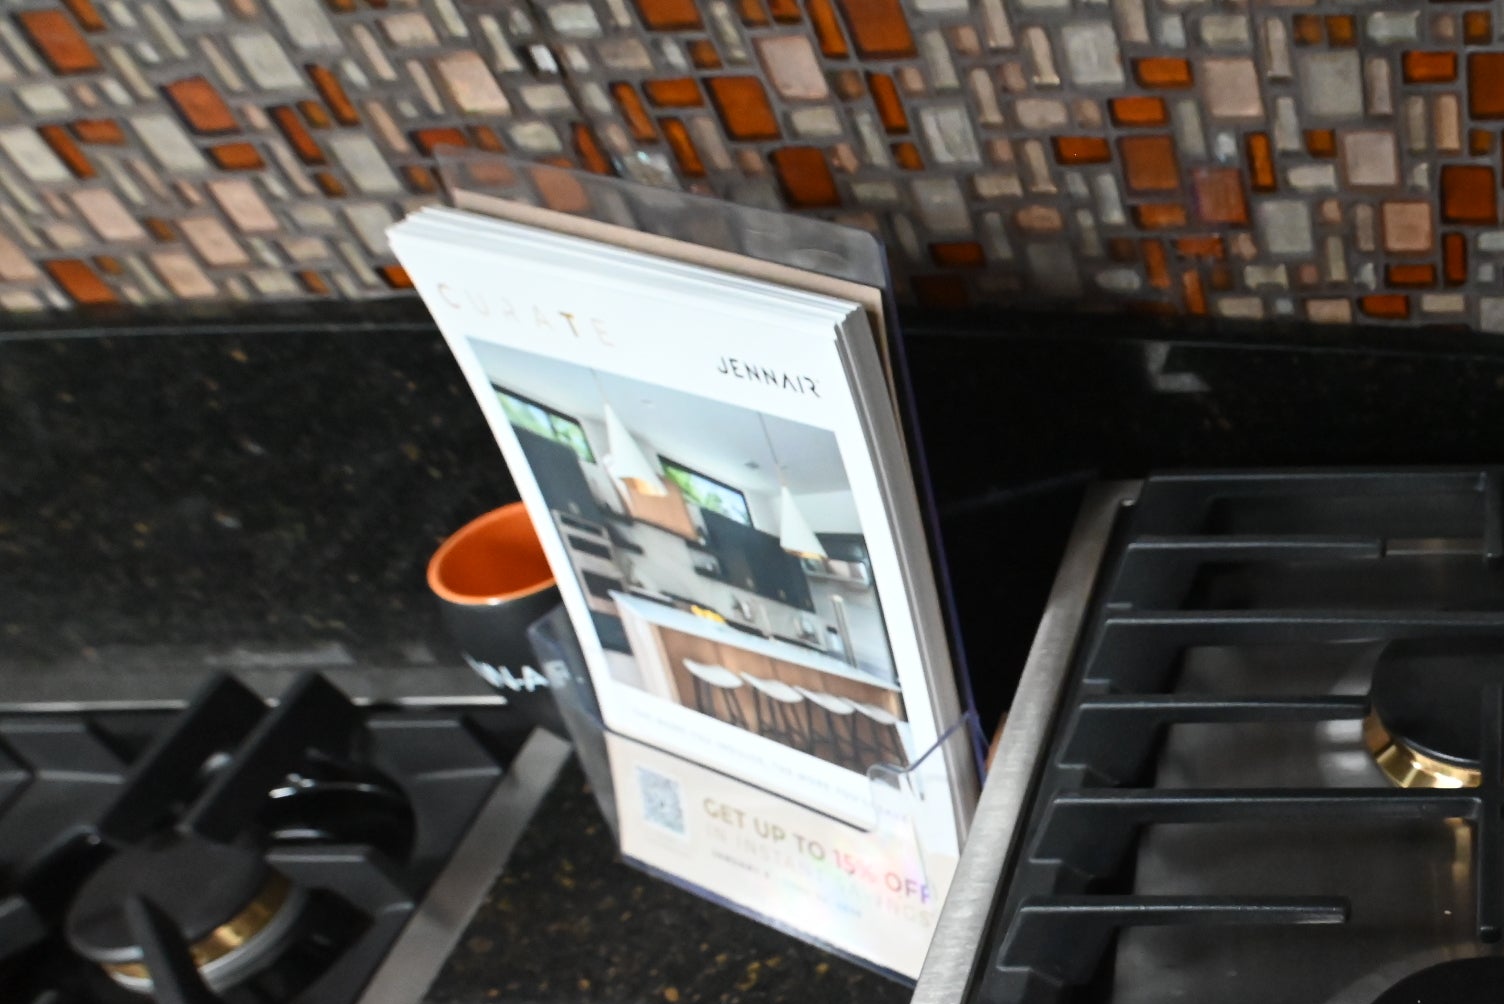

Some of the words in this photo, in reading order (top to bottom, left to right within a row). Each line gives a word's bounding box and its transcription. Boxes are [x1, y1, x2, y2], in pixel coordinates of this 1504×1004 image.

[717, 356, 821, 398] JENNAIR
[704, 798, 747, 829] GET
[753, 817, 787, 842] UP
[793, 834, 827, 862] TO
[884, 871, 931, 905] OFF
